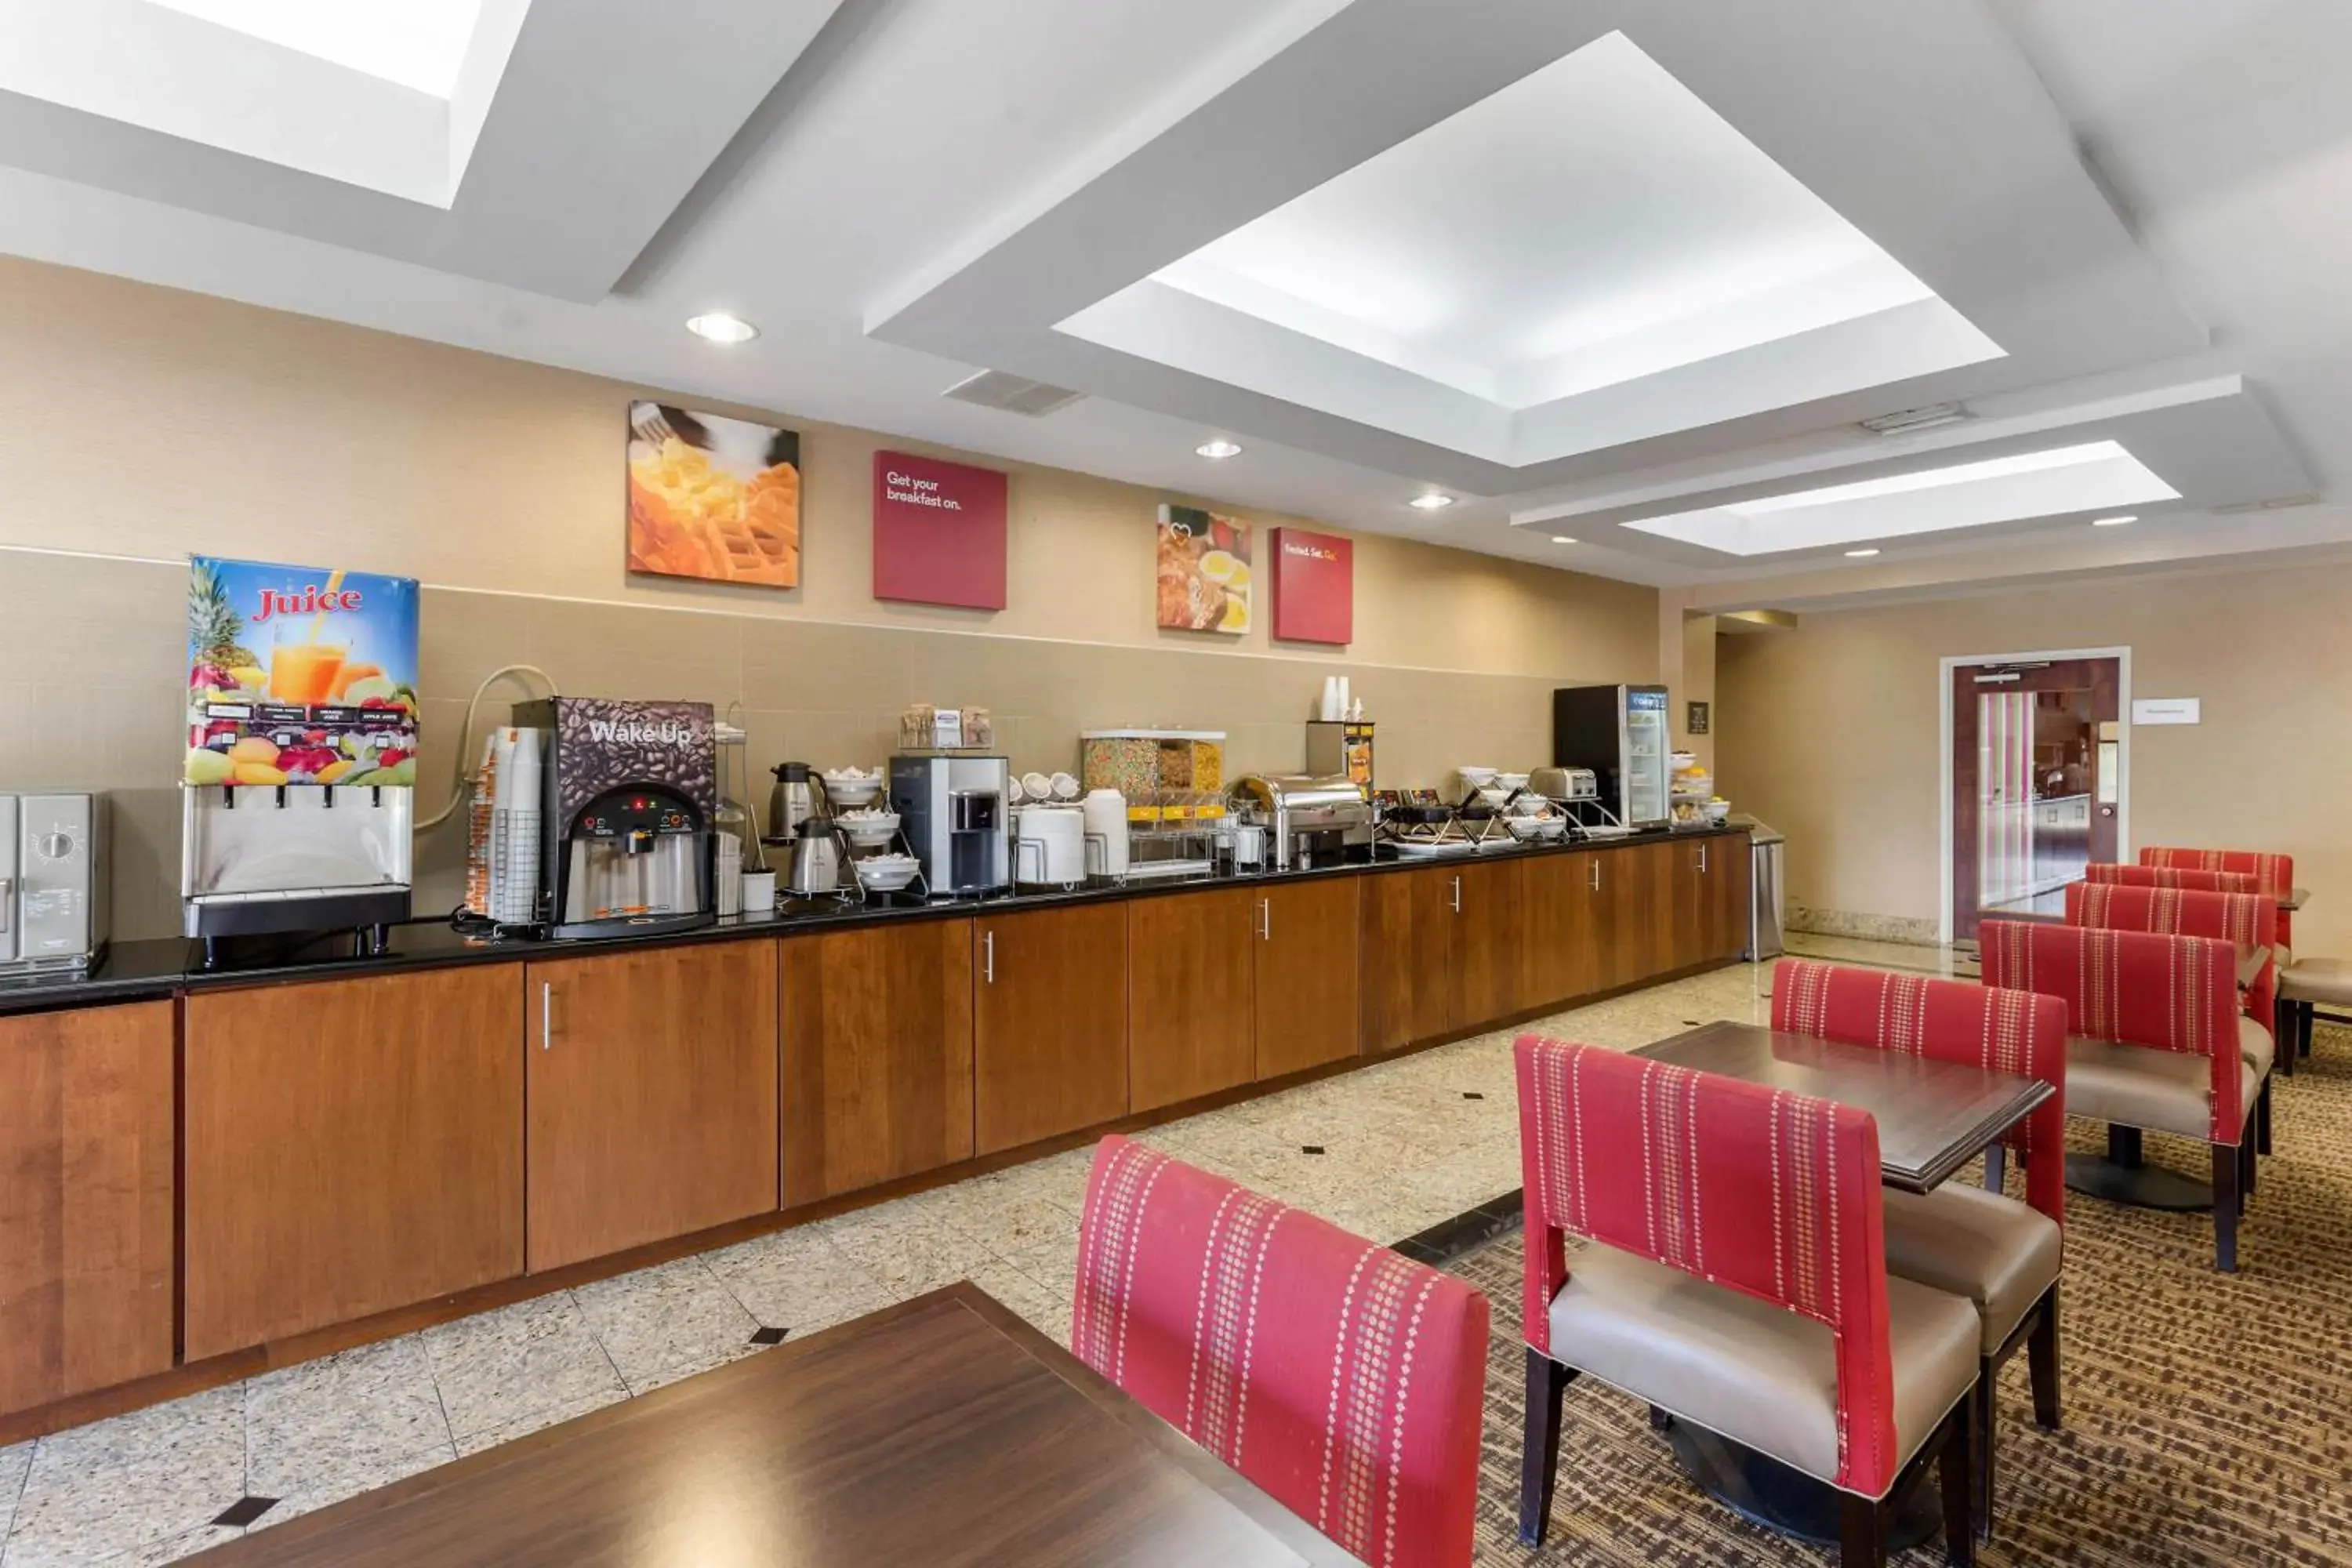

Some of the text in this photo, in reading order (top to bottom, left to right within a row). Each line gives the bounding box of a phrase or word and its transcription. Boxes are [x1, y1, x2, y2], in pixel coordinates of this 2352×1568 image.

[887, 471, 938, 491] Get your
[887, 486, 962, 510] breakfast on.
[251, 584, 363, 622] Juice
[589, 720, 691, 752] Wake Up
